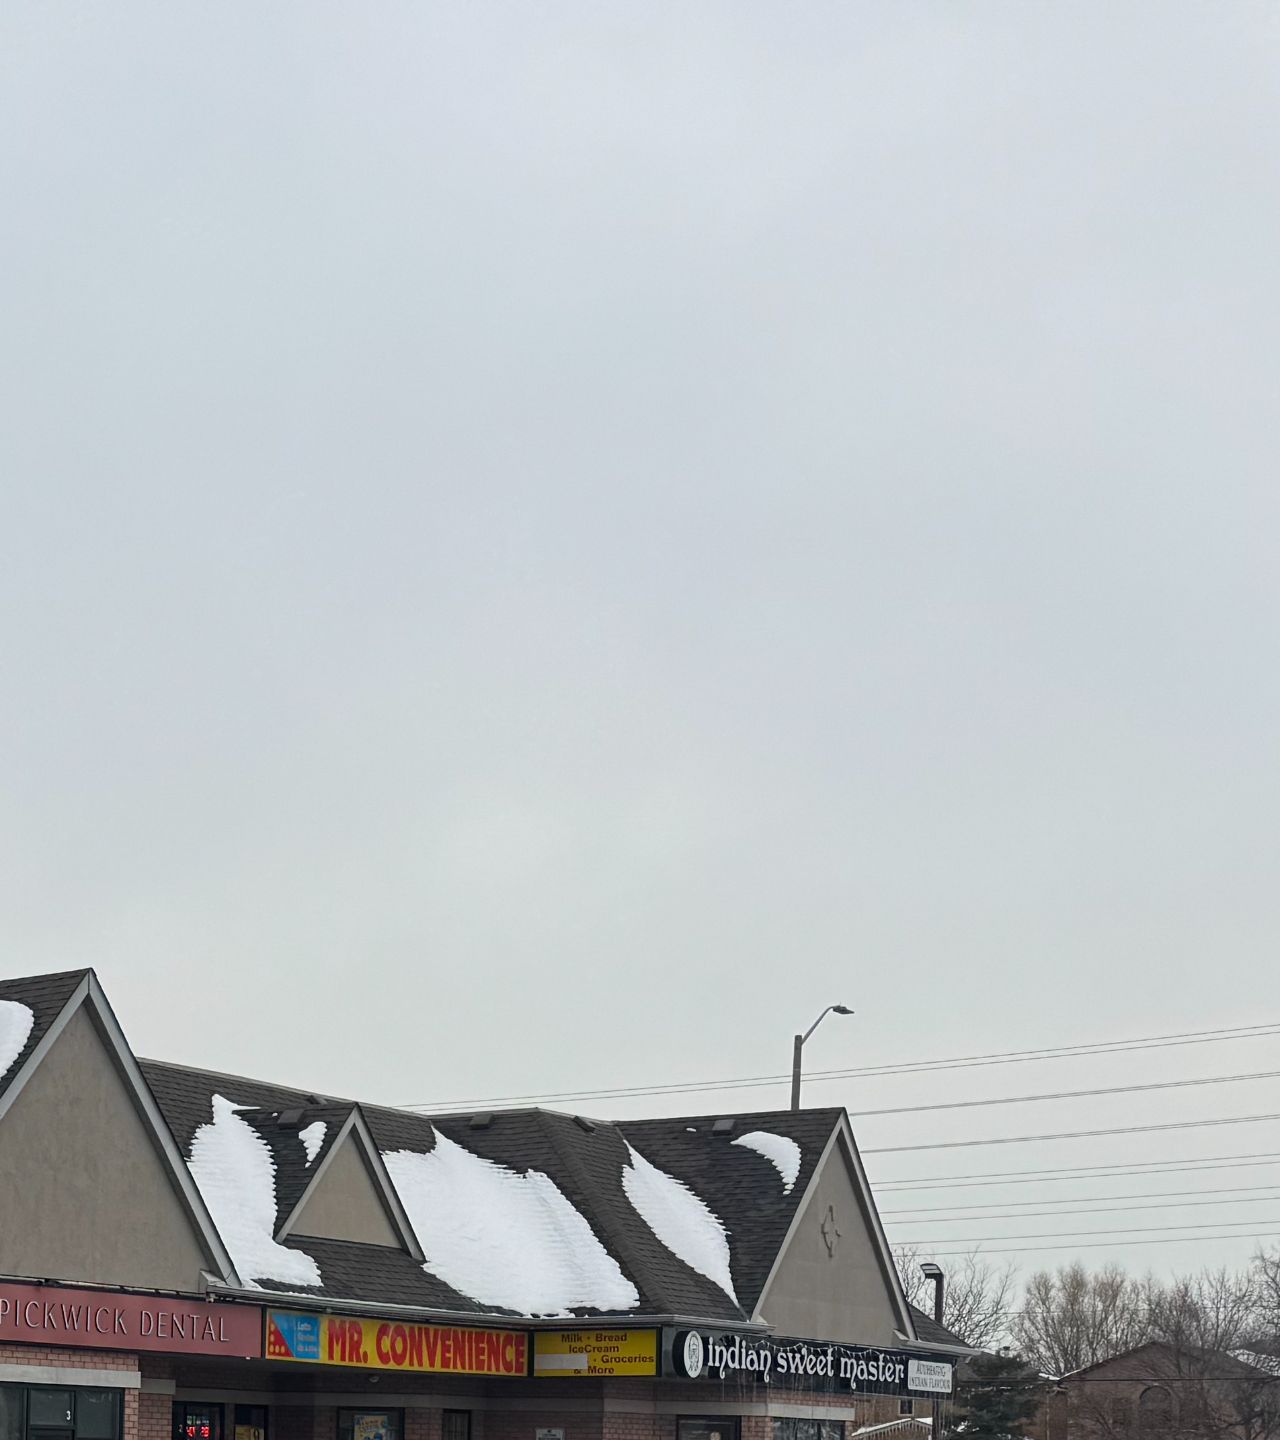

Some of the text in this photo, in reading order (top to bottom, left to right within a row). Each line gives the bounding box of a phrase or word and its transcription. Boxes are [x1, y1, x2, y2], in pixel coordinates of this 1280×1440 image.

[140, 1310, 230, 1342] DENTAL
[561, 1332, 627, 1343] Milk Bread
[326, 1319, 526, 1374] MR. CONVENIENCE
[568, 1344, 620, 1353] IceCream
[601, 1354, 654, 1364] Groceries
[707, 1336, 905, 1389] indian sweet master
[587, 1365, 614, 1374] More
[66, 1410, 71, 1420] 3
